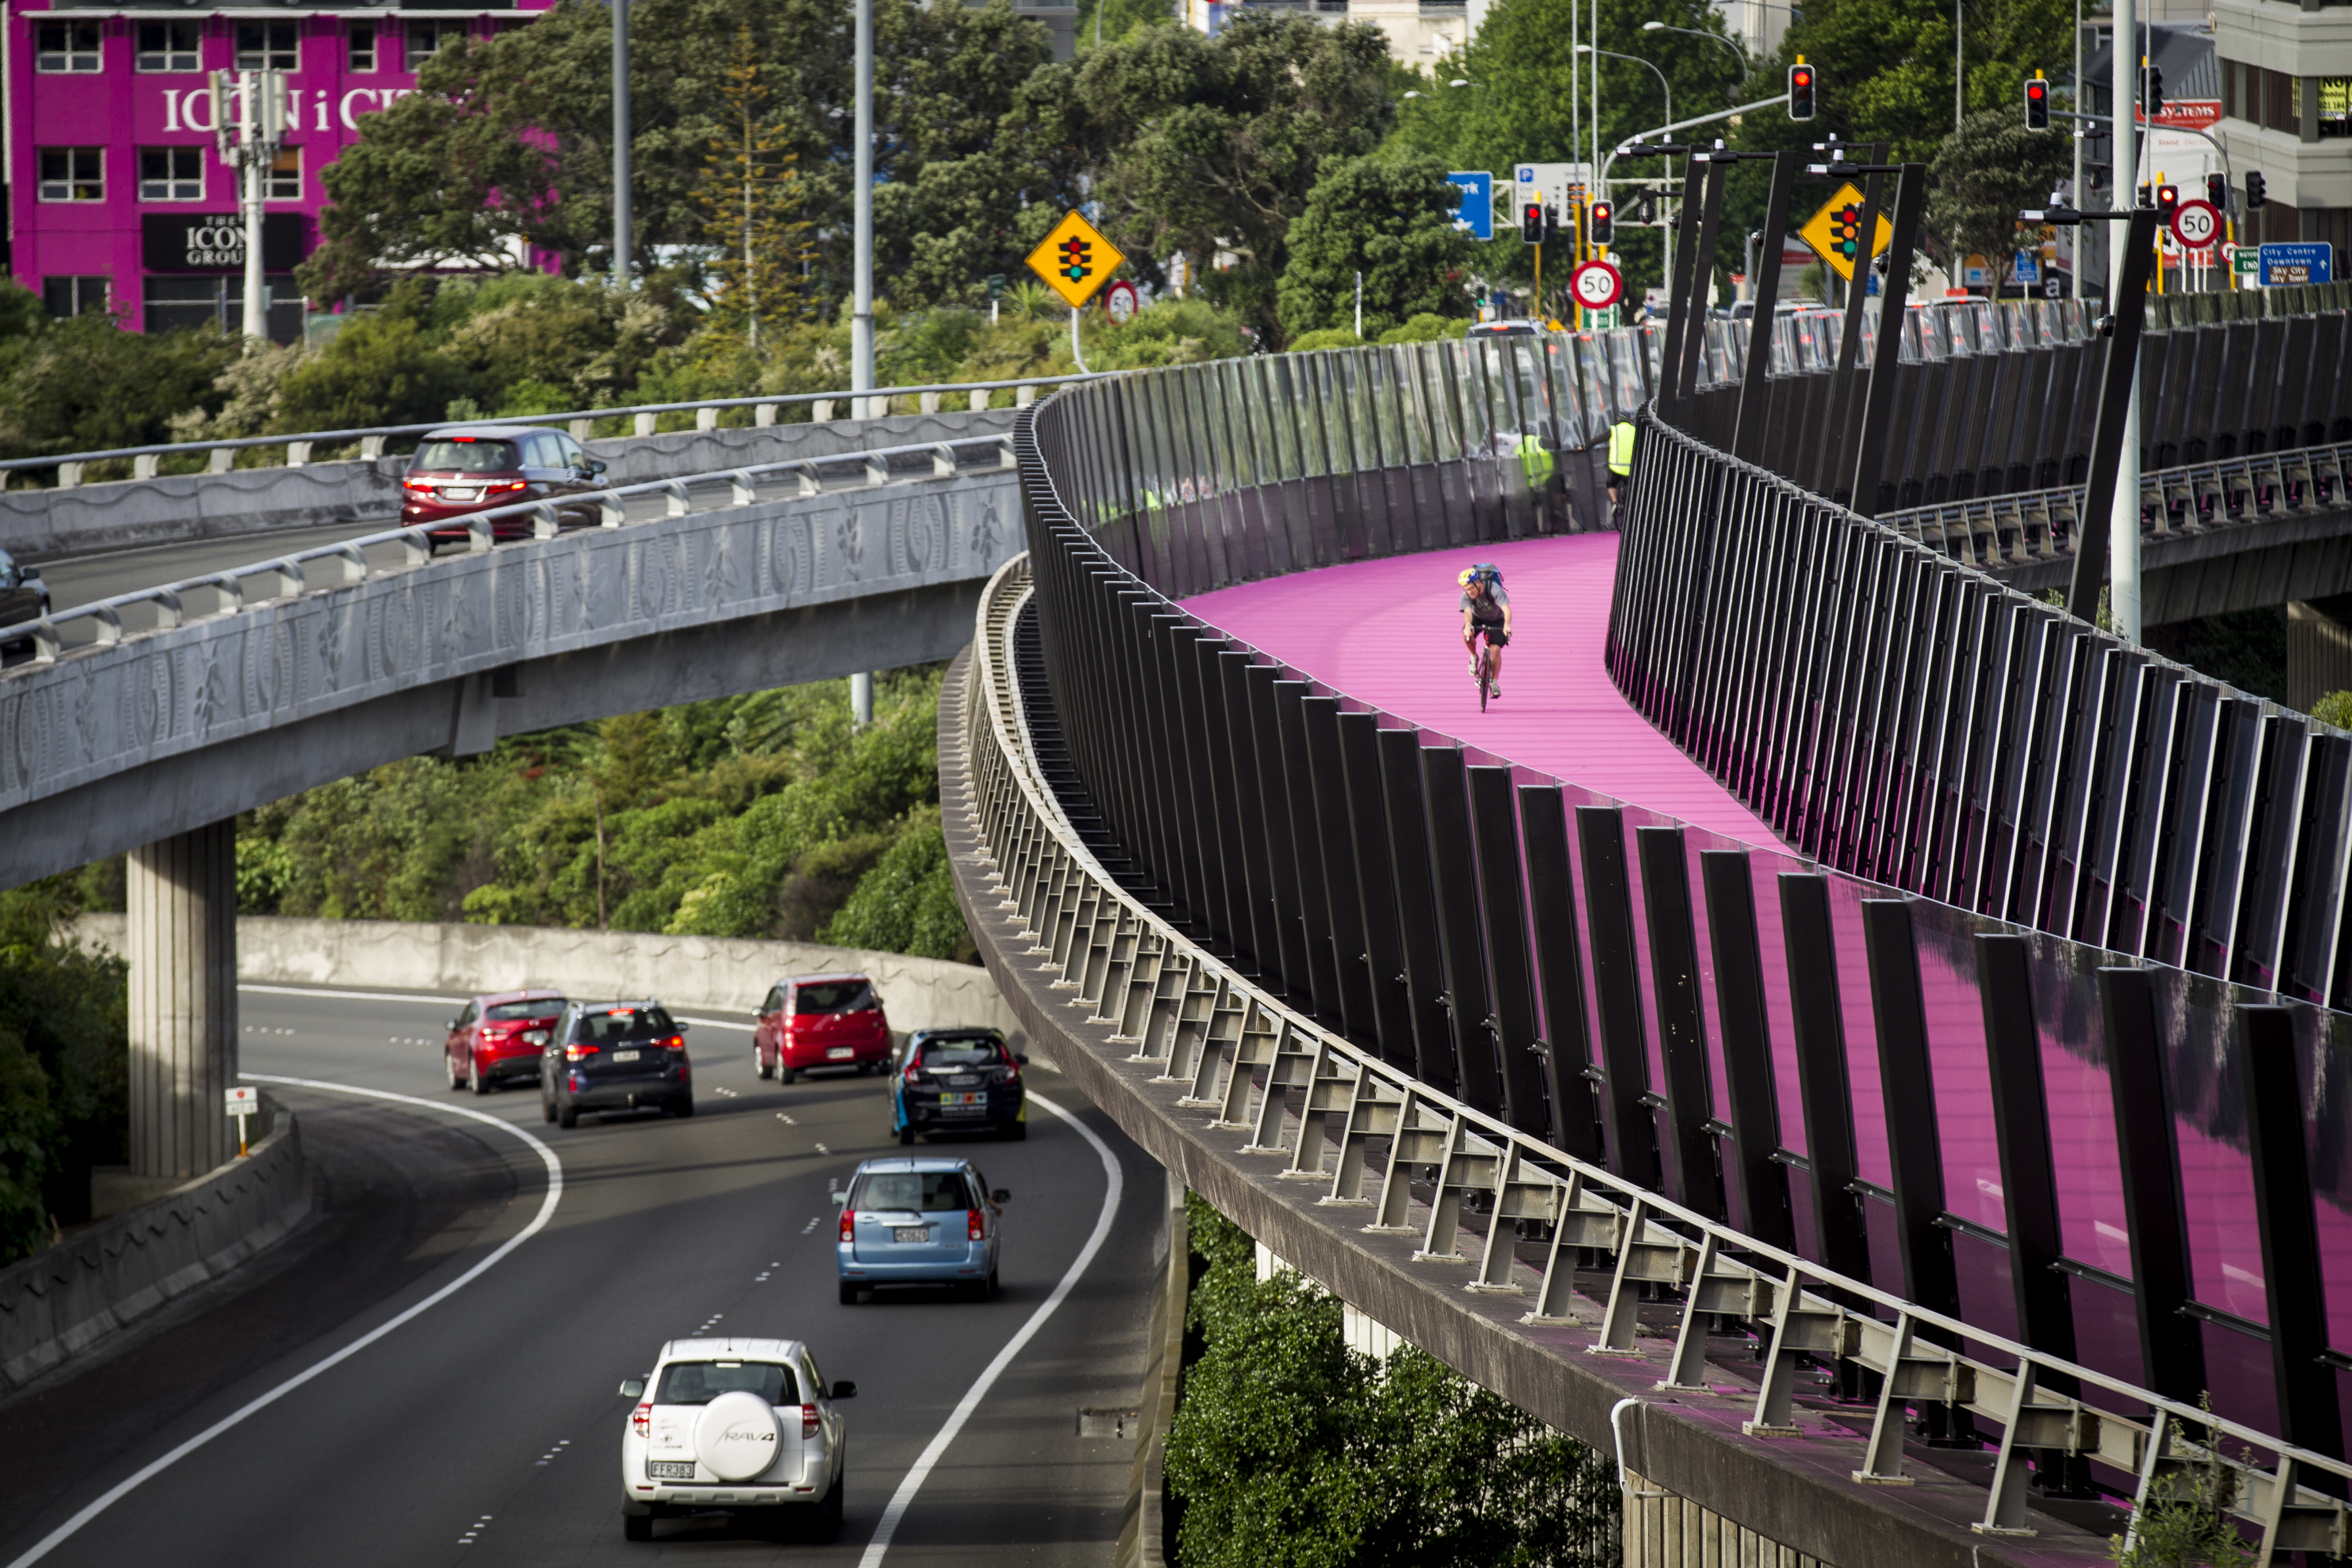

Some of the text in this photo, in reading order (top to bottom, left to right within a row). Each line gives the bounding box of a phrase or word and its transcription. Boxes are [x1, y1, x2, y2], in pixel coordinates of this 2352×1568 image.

[315, 90, 331, 131] i
[205, 216, 237, 226] THE
[2184, 216, 2210, 233] 50
[2263, 247, 2316, 257] City Centre
[186, 250, 246, 265] GROU
[2267, 257, 2312, 266] Downtown
[2272, 266, 2306, 275] Sky City
[2270, 274, 2309, 283] Sky Tower
[1585, 276, 1610, 294] 50
[725, 1432, 774, 1441] RAV4
[653, 1463, 692, 1475] FFR383
